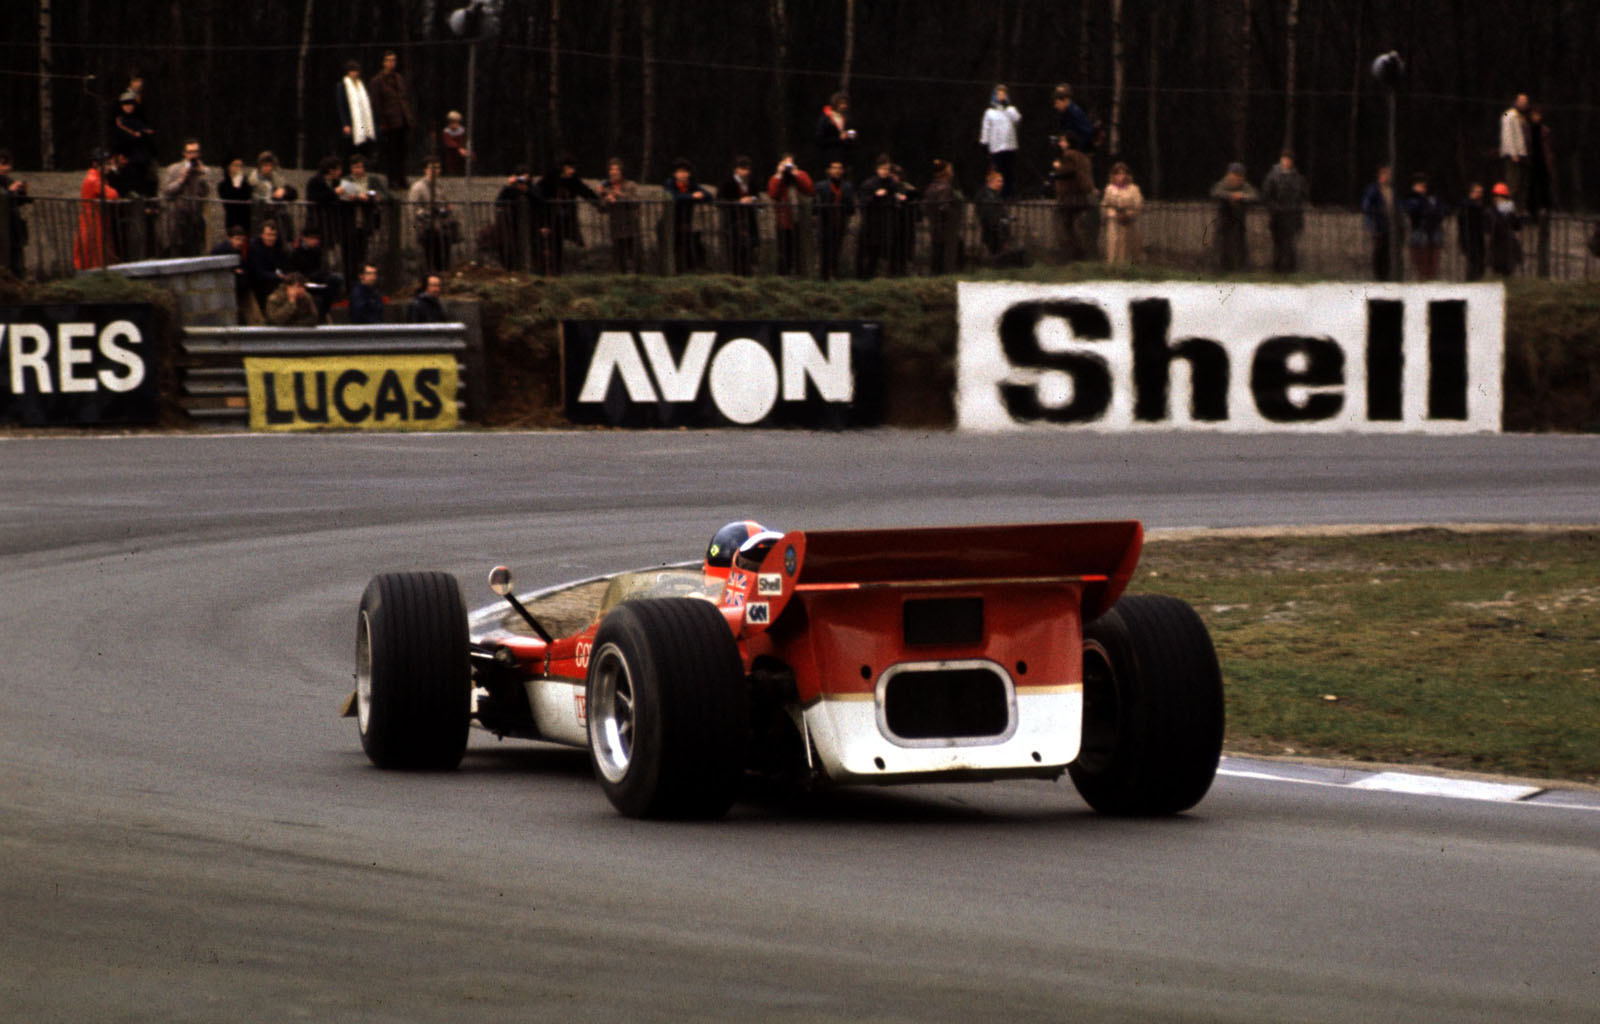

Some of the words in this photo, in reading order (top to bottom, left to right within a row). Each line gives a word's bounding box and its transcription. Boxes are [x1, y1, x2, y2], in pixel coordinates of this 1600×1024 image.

[578, 331, 854, 424] AVON
[997, 297, 1468, 423] Shell
[263, 368, 443, 425] LUCAS
[759, 578, 781, 592] Shell
[576, 642, 593, 668] GO
